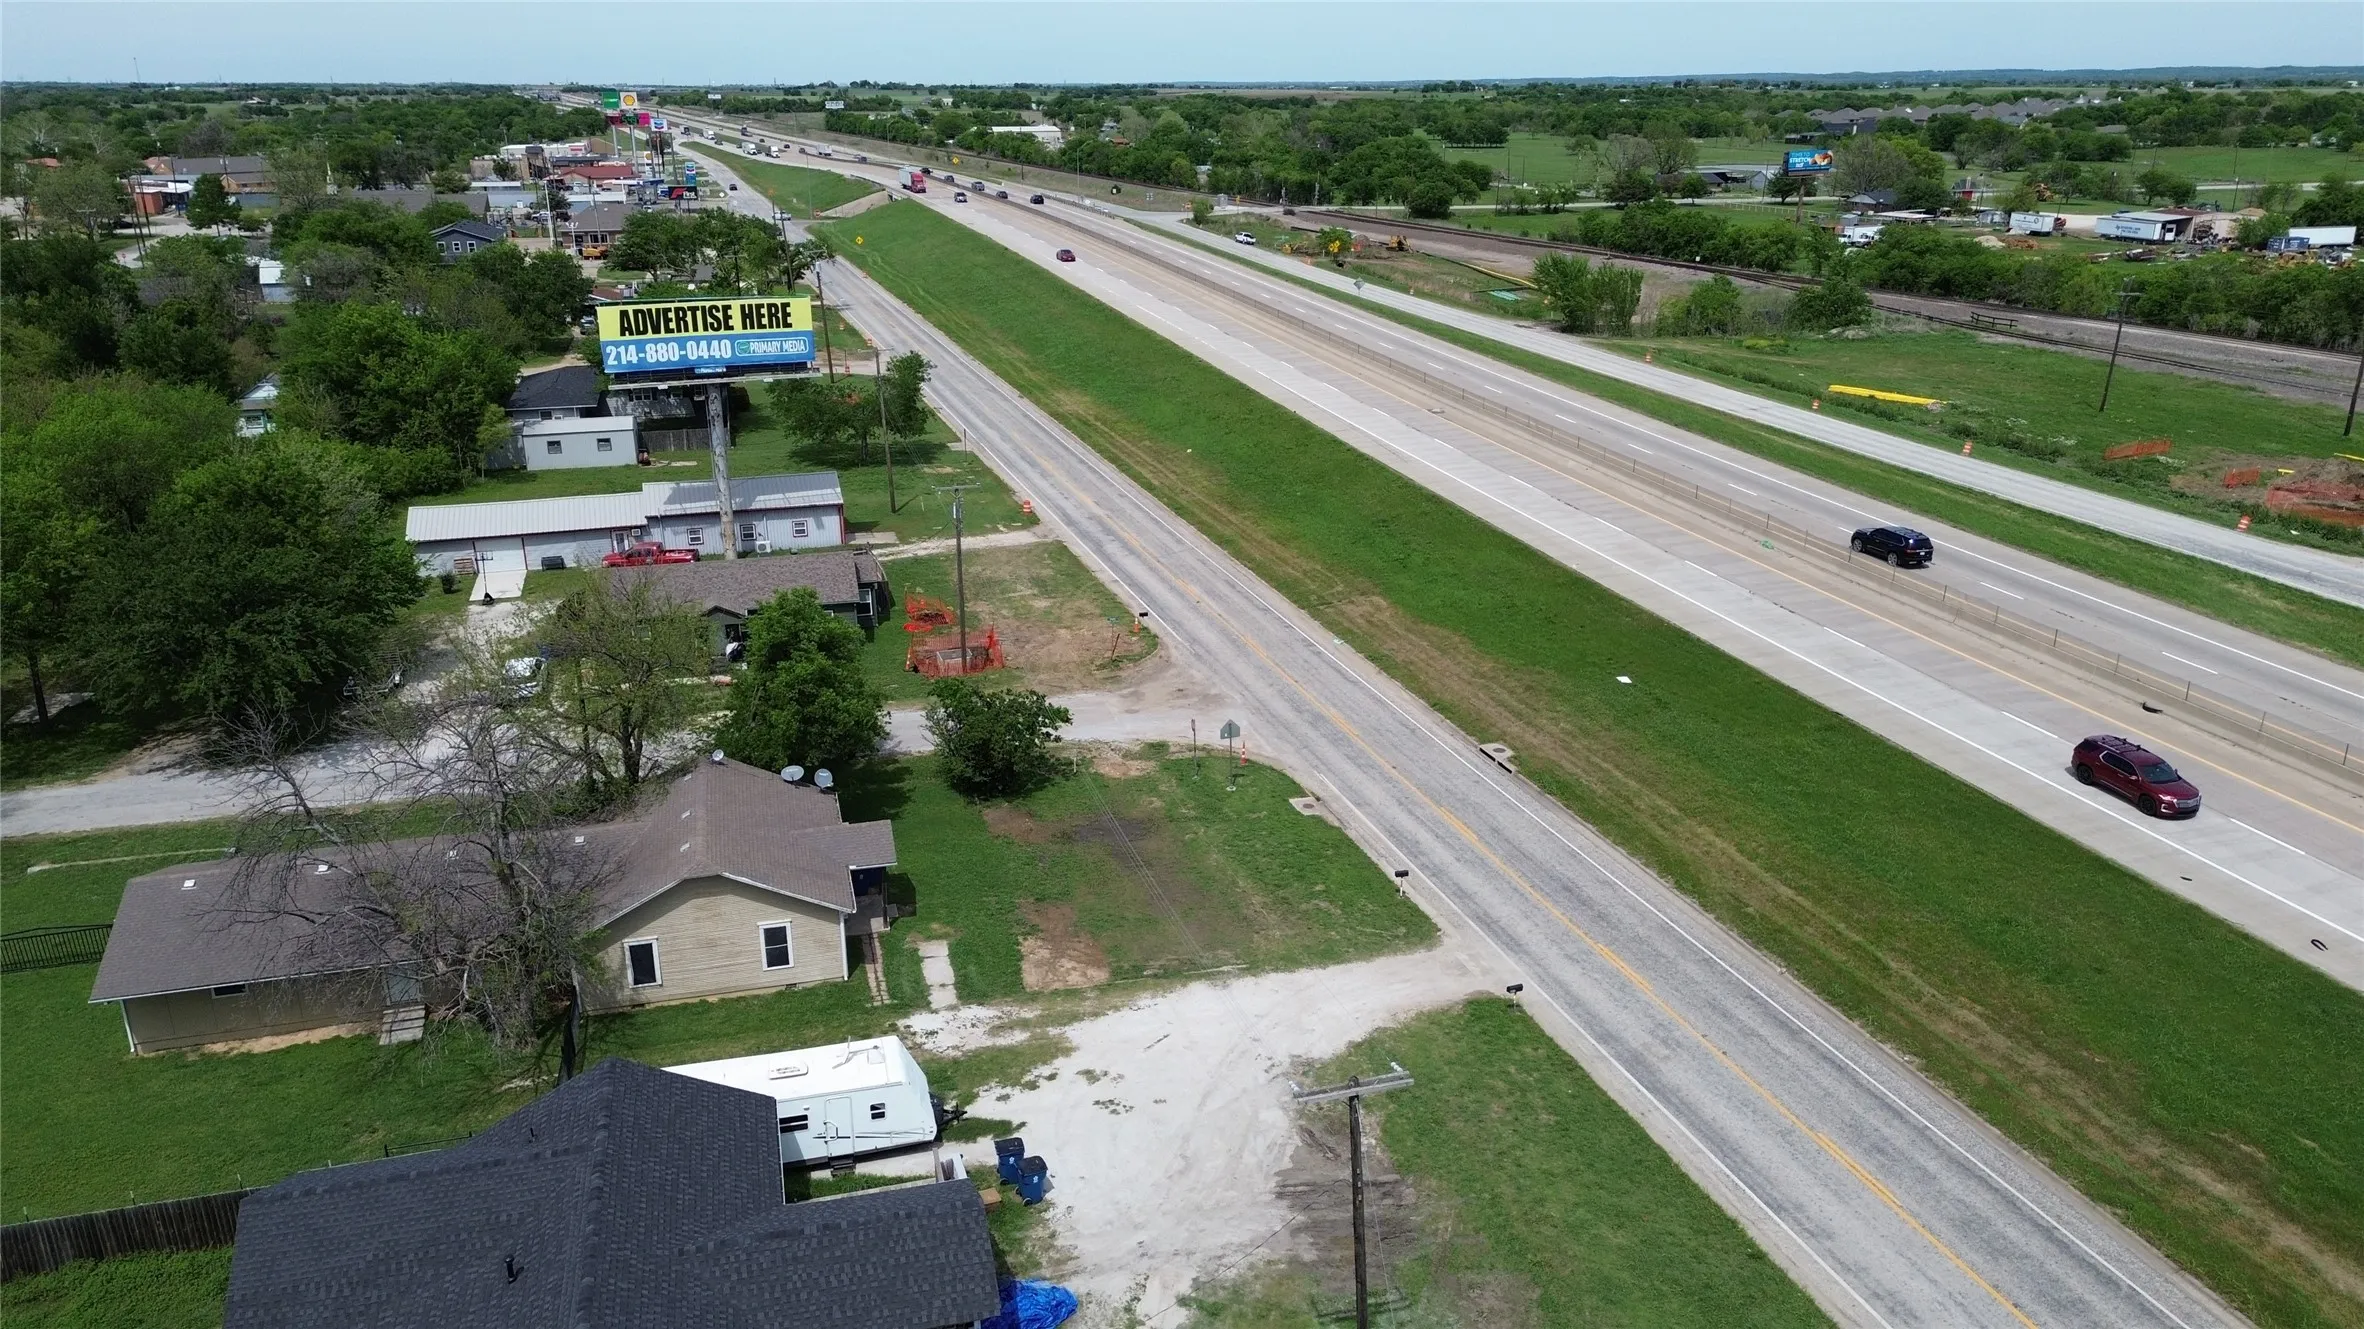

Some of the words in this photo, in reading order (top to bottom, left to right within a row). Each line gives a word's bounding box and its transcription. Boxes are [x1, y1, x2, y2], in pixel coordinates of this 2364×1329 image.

[619, 304, 735, 337] ADVERTISE
[740, 302, 793, 330] HERE
[605, 339, 732, 366] 214-880-0440
[750, 341, 781, 354] PRIMARY
[782, 339, 806, 352] MEDIA
